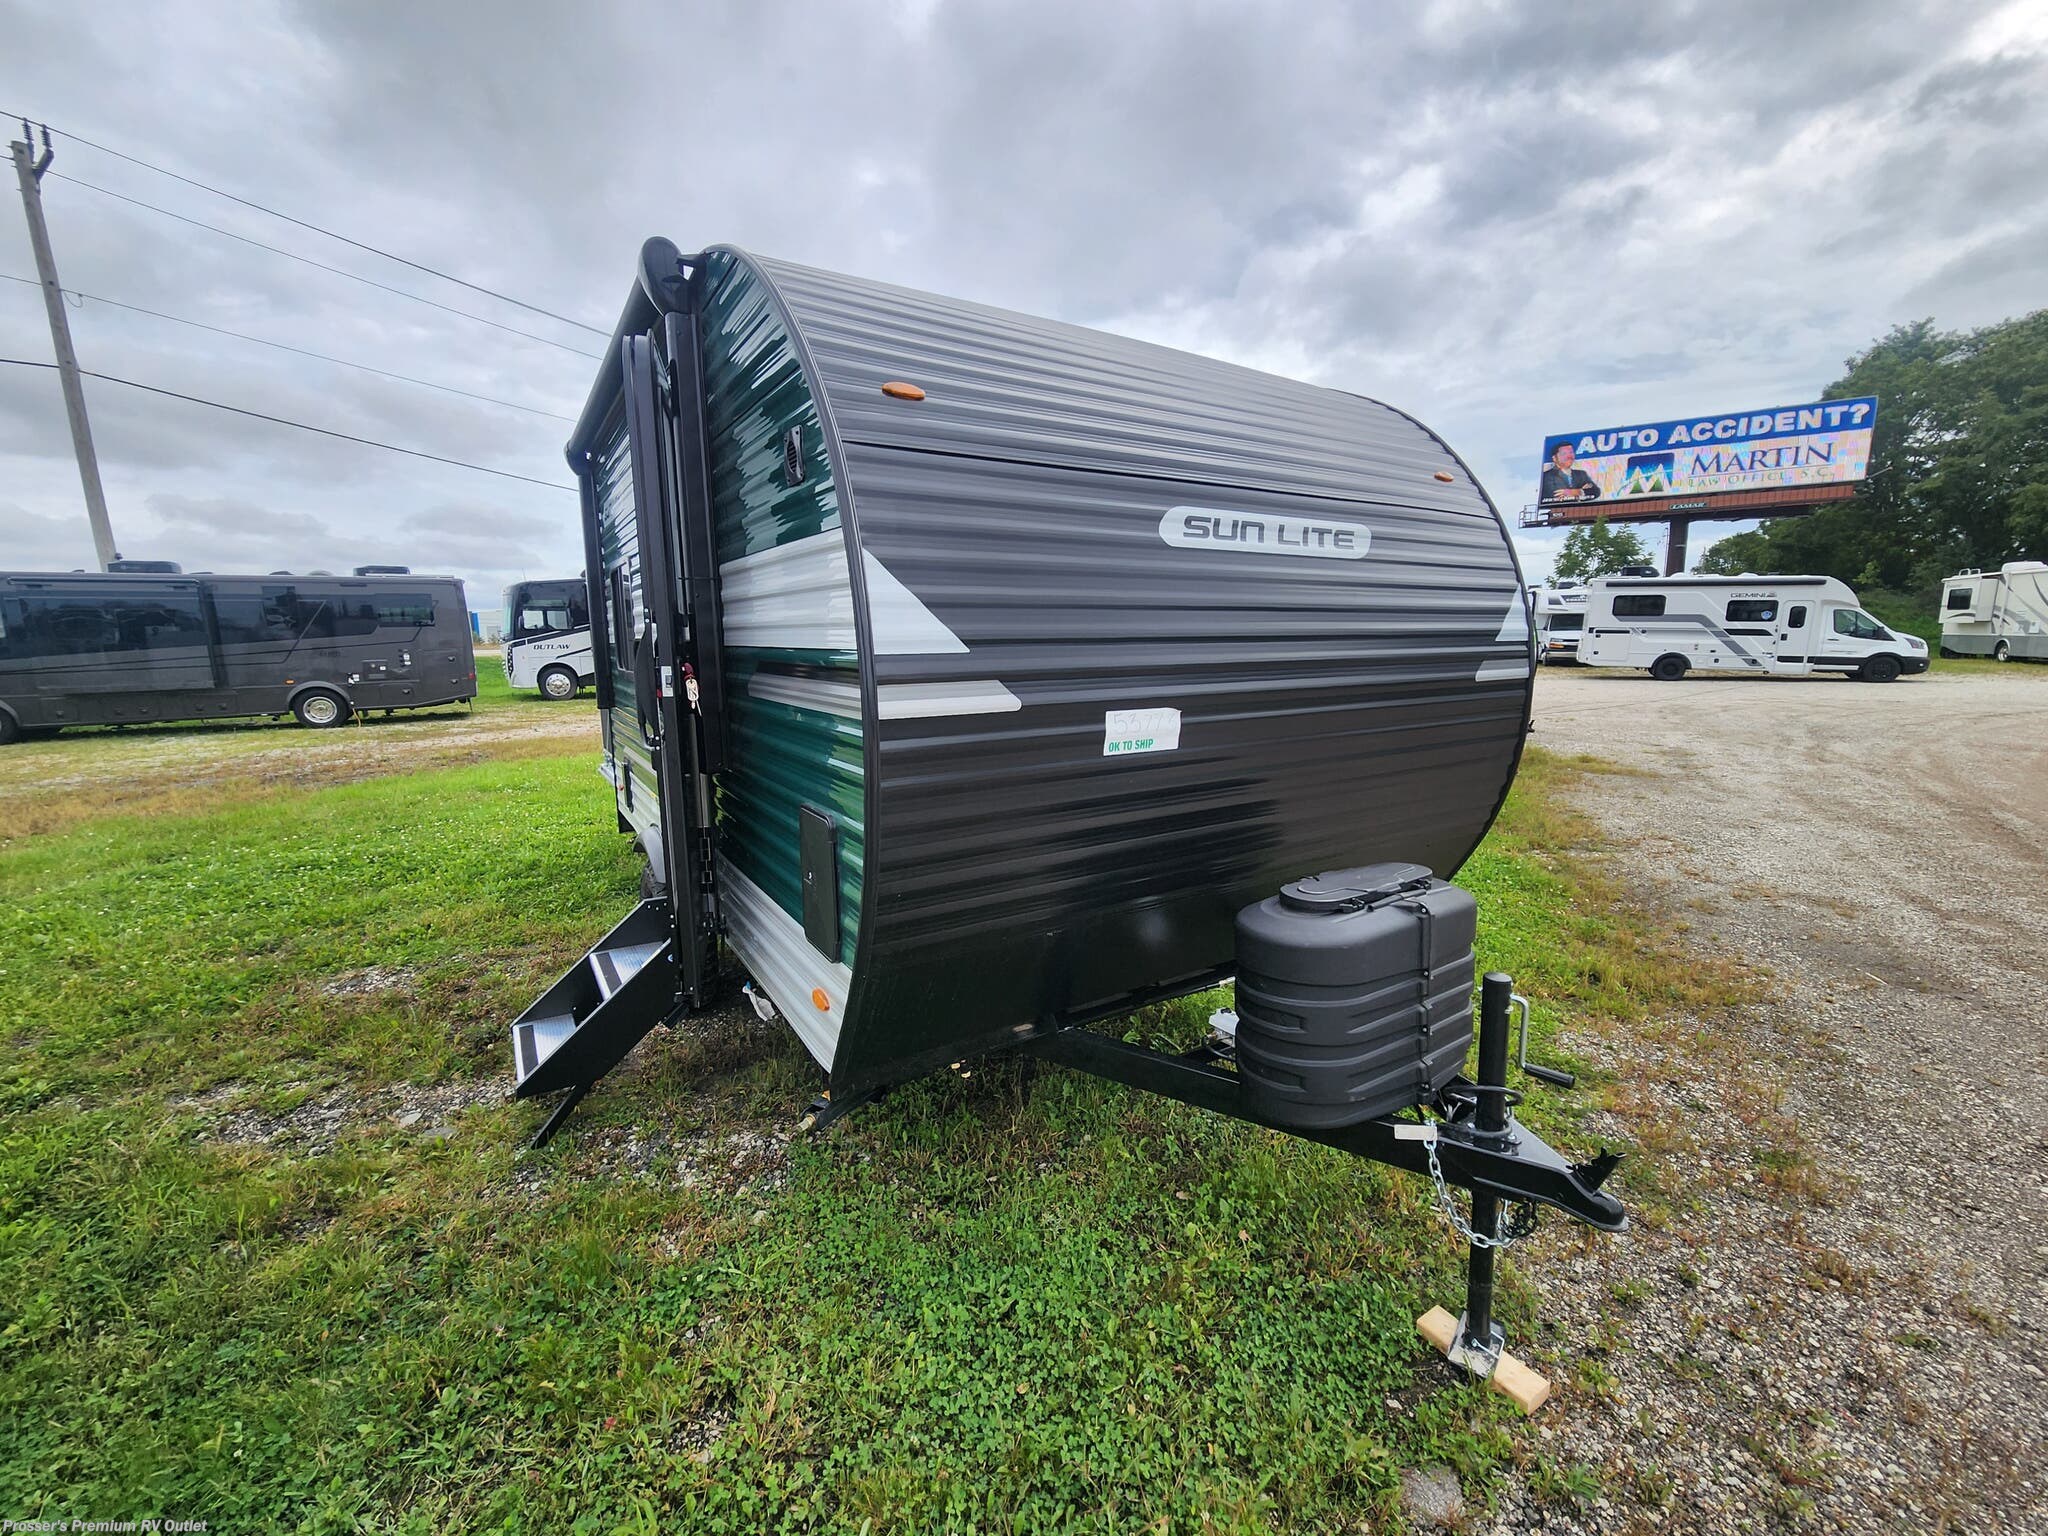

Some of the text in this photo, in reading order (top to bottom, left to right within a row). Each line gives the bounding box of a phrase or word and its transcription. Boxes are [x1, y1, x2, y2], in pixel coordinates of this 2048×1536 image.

[1576, 404, 1870, 454] AUTO ACCIDENT?
[1691, 443, 1833, 474] MARTIN
[1183, 515, 1355, 550] SUN LITE
[1108, 738, 1154, 752] OK TO SHIP
